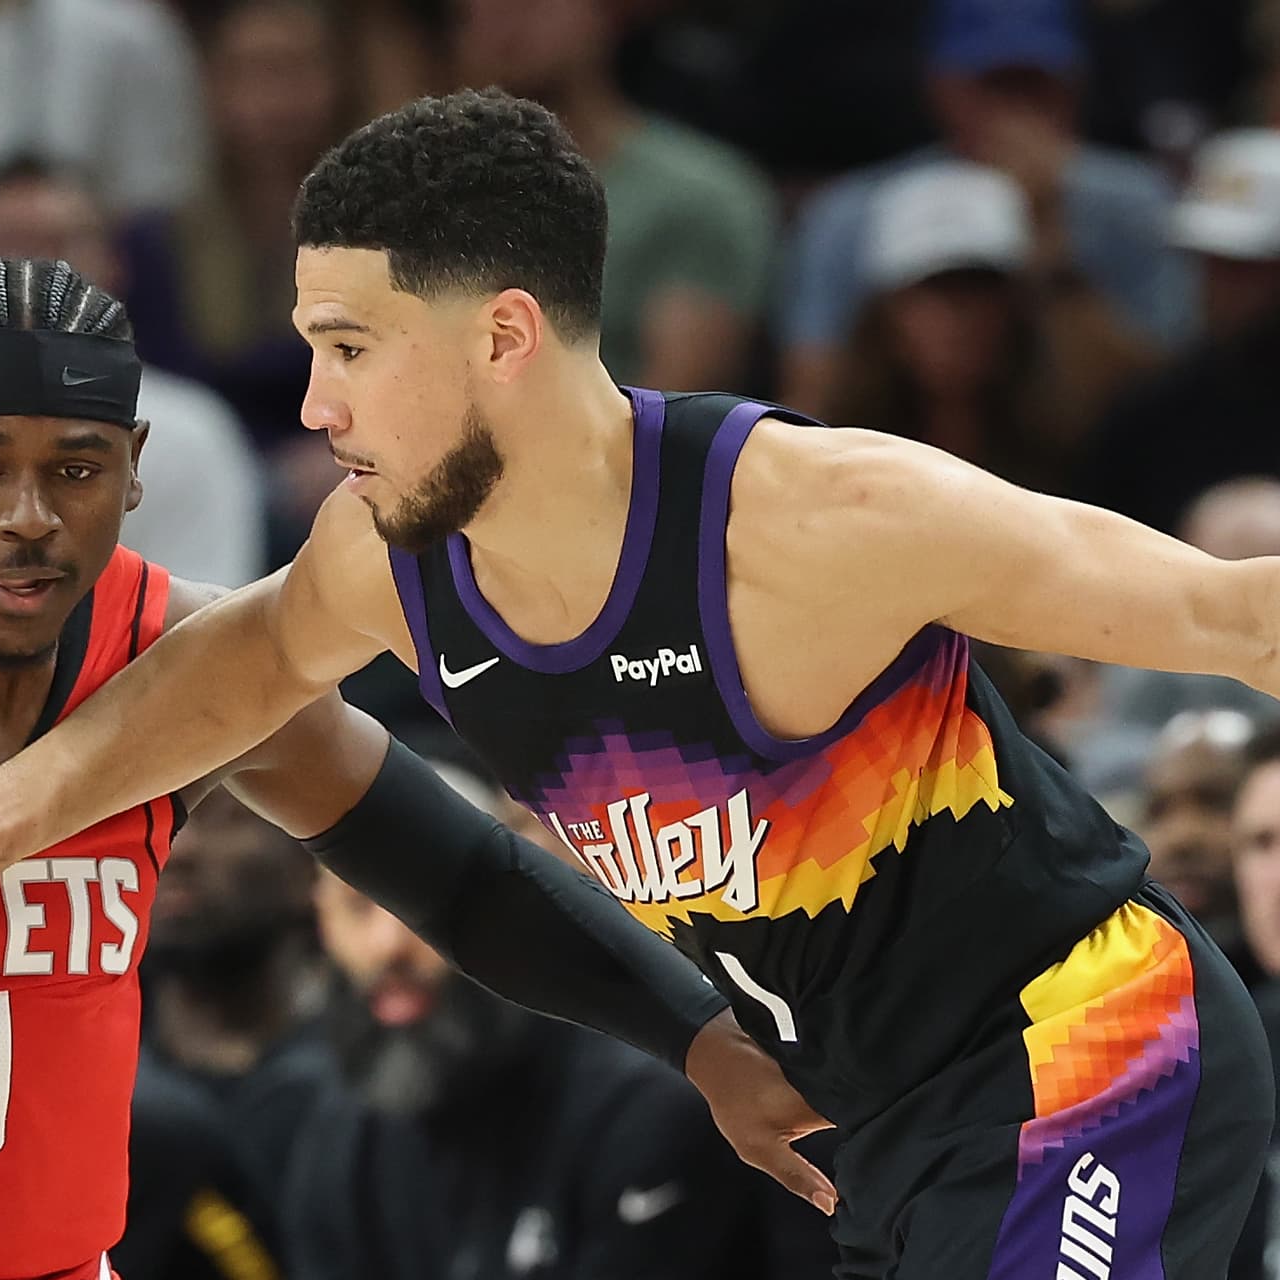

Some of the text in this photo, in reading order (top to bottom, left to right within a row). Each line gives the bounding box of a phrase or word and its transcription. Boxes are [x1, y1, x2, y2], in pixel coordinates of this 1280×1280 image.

[610, 644, 703, 687] PayPal
[568, 820, 605, 841] THE
[714, 951, 798, 1042] 1
